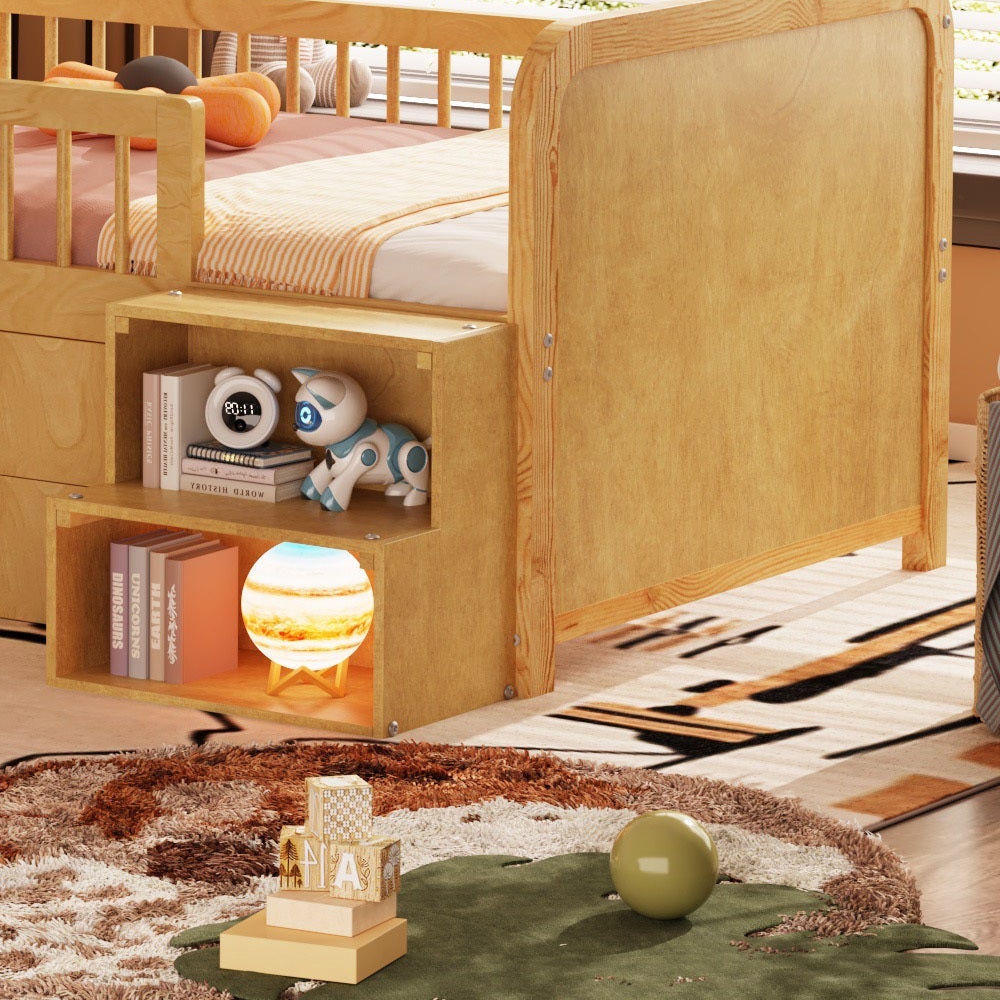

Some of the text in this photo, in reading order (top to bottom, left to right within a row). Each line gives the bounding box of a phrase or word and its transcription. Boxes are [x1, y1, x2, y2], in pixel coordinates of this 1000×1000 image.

[112, 572, 124, 649] DINOSAURS
[131, 573, 141, 658] UNICORNS
[151, 583, 161, 649] EARTH
[331, 852, 363, 890] A
